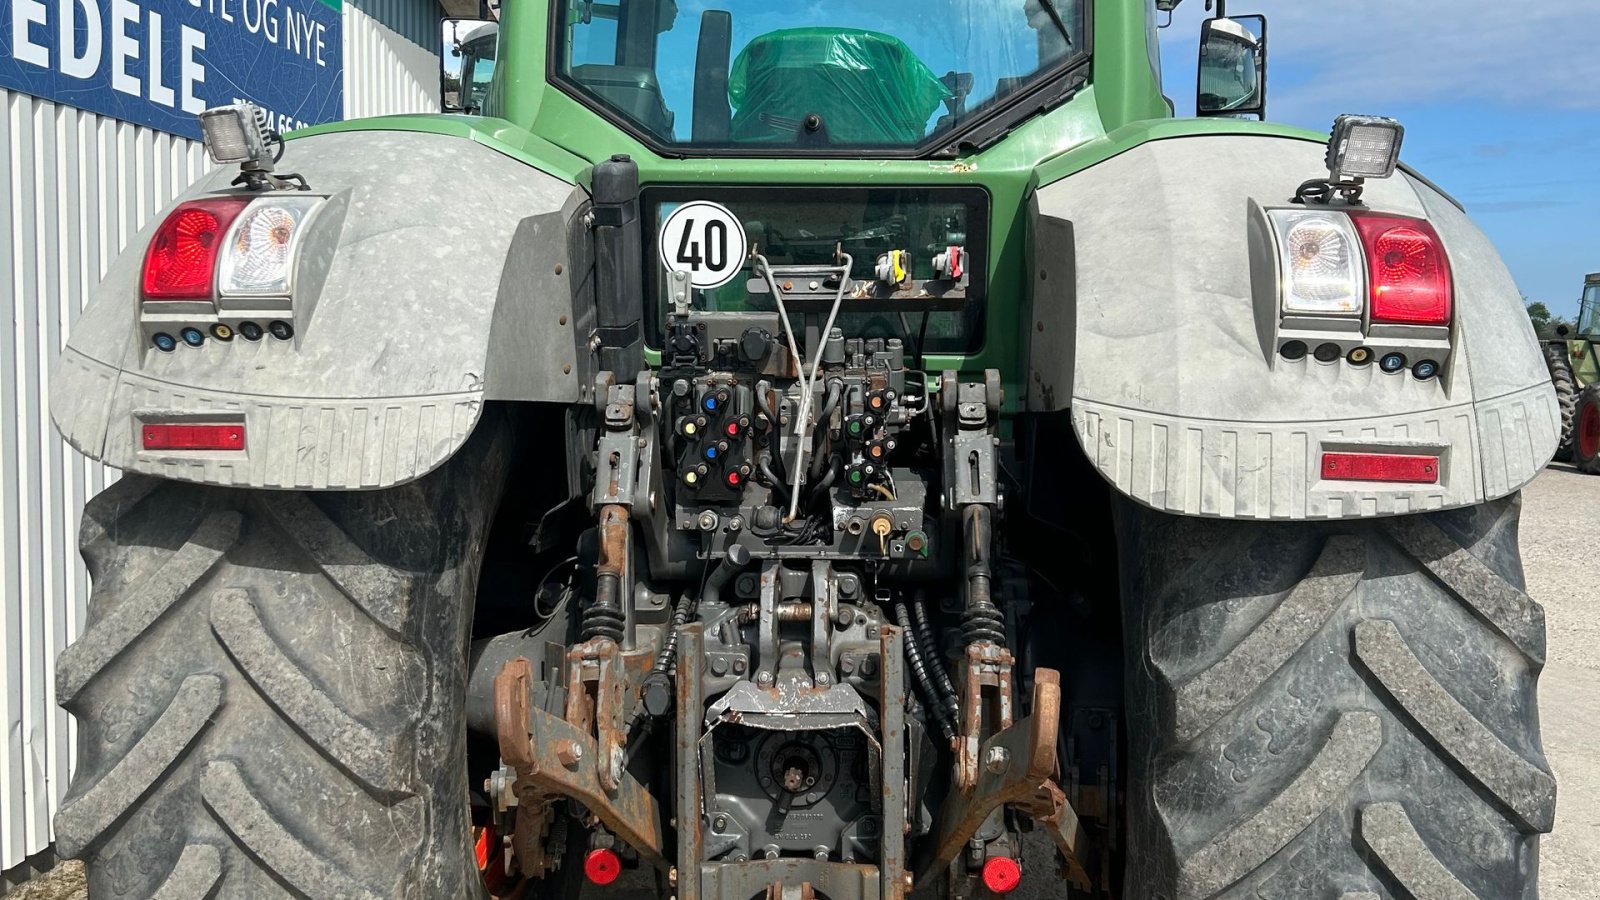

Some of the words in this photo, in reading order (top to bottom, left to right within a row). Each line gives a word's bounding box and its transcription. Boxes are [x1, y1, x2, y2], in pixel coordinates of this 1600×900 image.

[12, 0, 206, 115] EDELE
[243, 0, 278, 43] OG
[286, 6, 326, 67] NYE
[677, 219, 727, 272] 40
